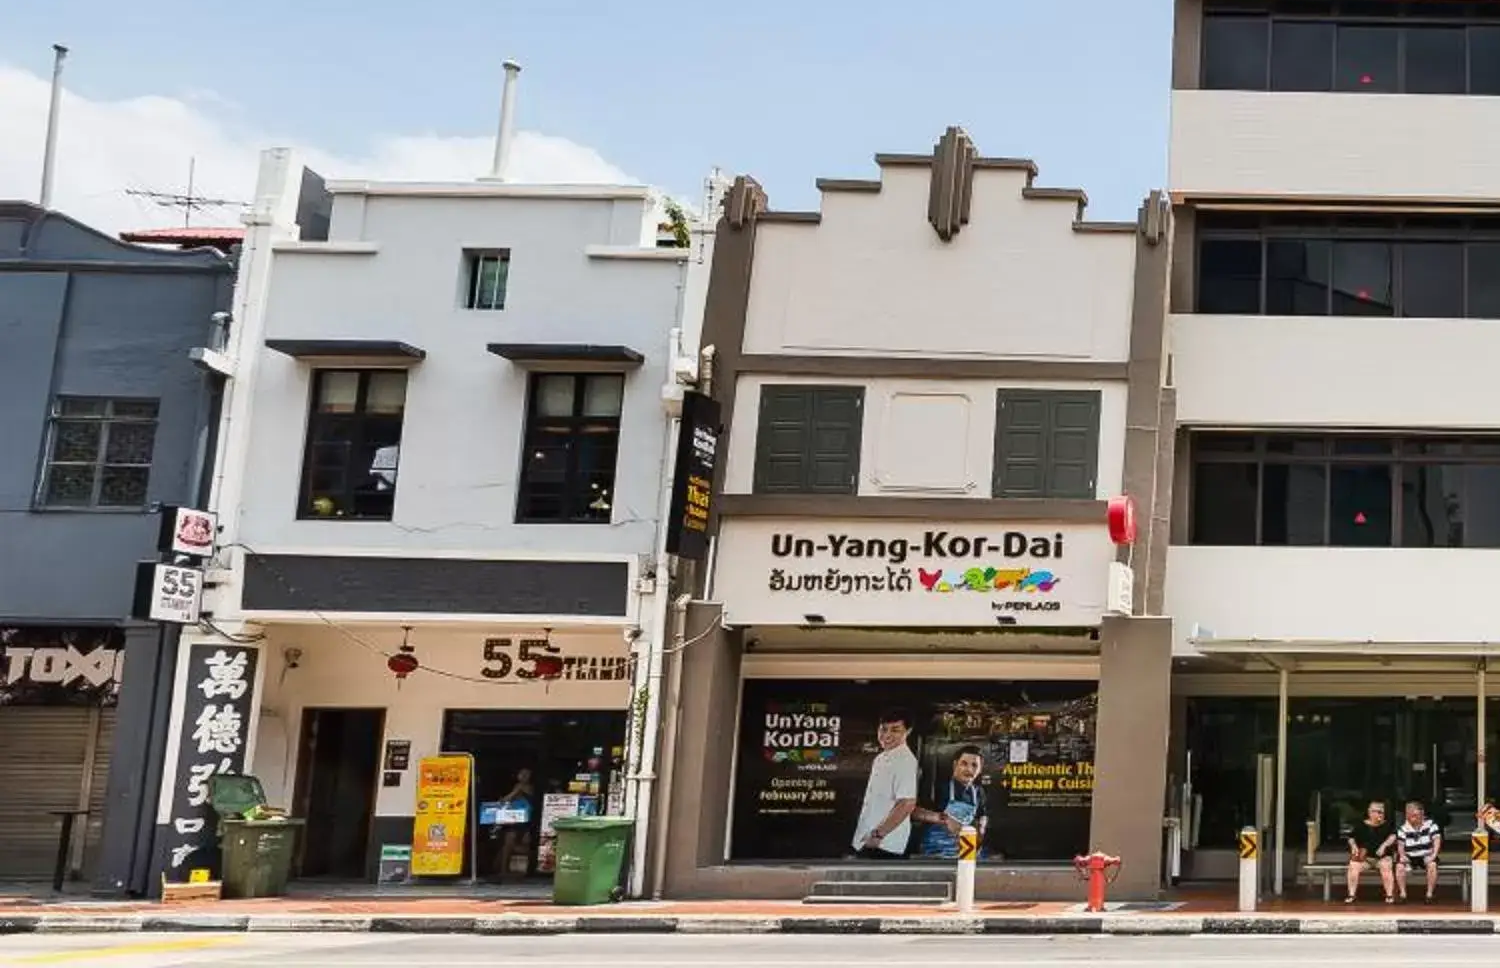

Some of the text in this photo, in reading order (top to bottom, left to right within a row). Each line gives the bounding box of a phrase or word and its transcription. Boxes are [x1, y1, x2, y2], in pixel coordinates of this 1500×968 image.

[771, 531, 1063, 564] Un-Yang-Kor-Dai
[161, 569, 195, 598] 55
[481, 638, 547, 679] 55
[765, 713, 841, 732] UnYang
[764, 730, 839, 747] KorDai
[1003, 761, 1074, 776] Authentic
[1011, 776, 1054, 789] Isaan
[760, 790, 809, 802] February
